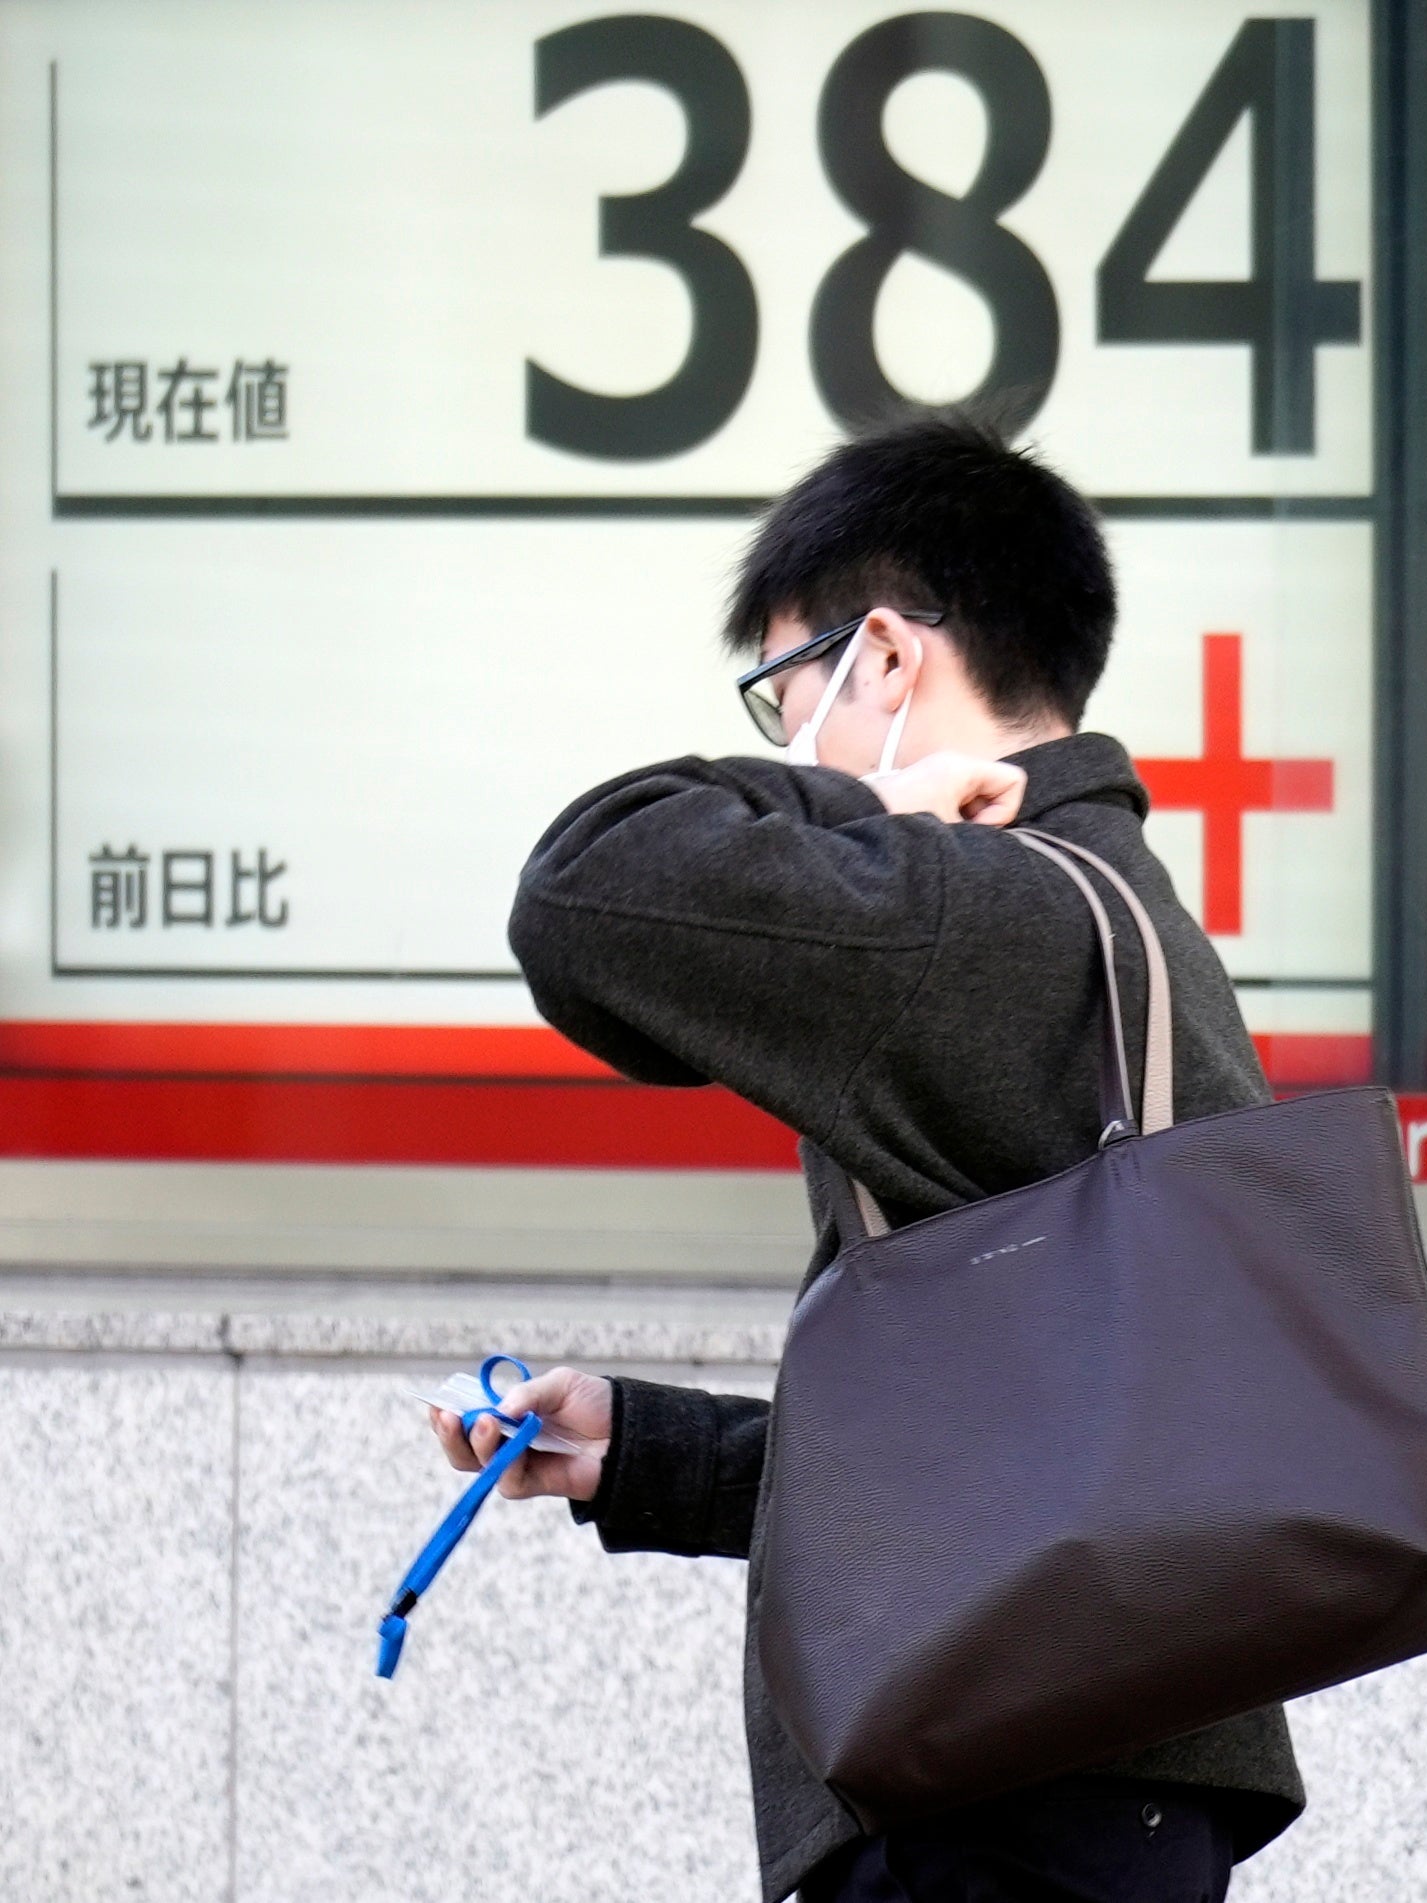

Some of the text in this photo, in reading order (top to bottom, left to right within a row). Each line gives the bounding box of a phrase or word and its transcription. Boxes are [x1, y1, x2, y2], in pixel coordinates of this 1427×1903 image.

[88, 358, 288, 442] 現在値
[88, 845, 288, 929] 前日比
